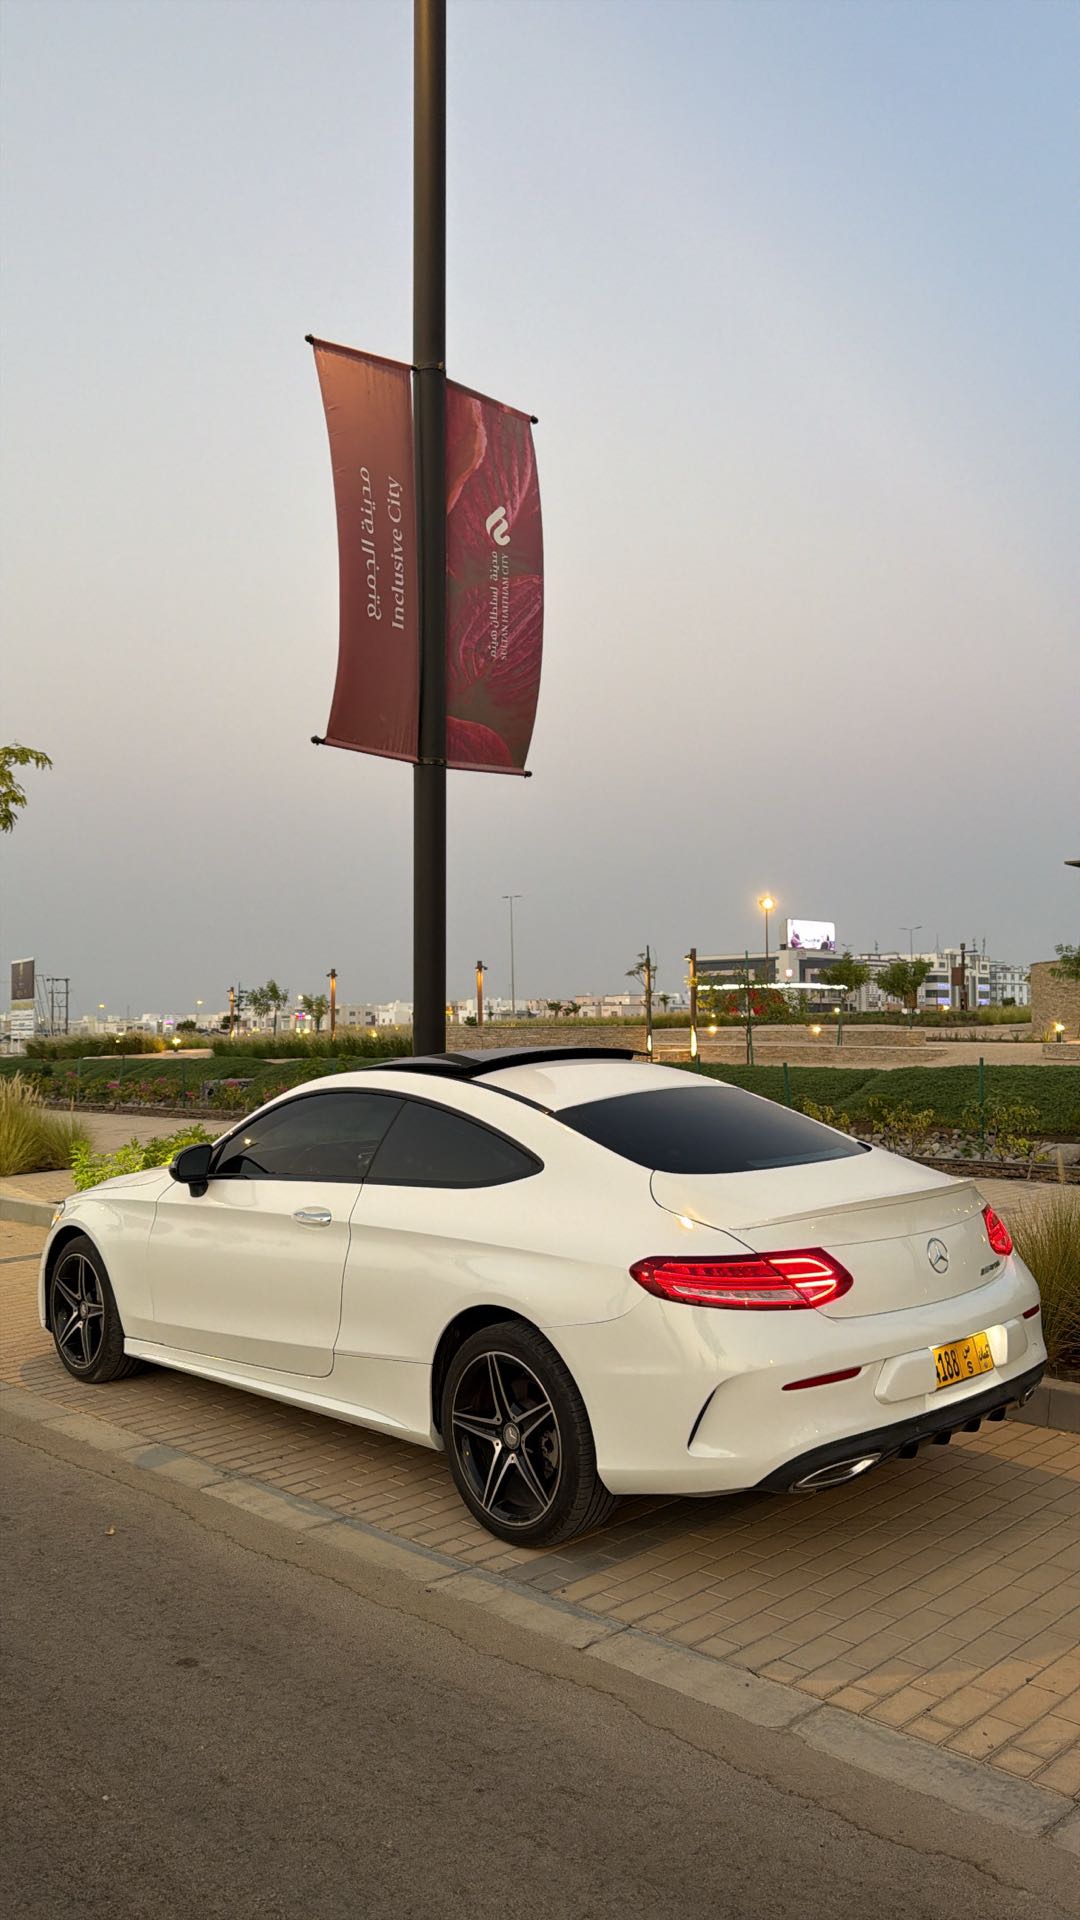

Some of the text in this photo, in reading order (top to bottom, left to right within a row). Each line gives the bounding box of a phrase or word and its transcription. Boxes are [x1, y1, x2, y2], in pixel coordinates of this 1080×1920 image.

[360, 466, 382, 621] مدينة الجميع
[387, 475, 405, 630] Inclusive City
[489, 551, 500, 581] مدينة
[489, 585, 500, 628] لسلطان
[500, 553, 510, 660] SULTAN HAITHAM CITY
[966, 1360, 974, 1374] S
